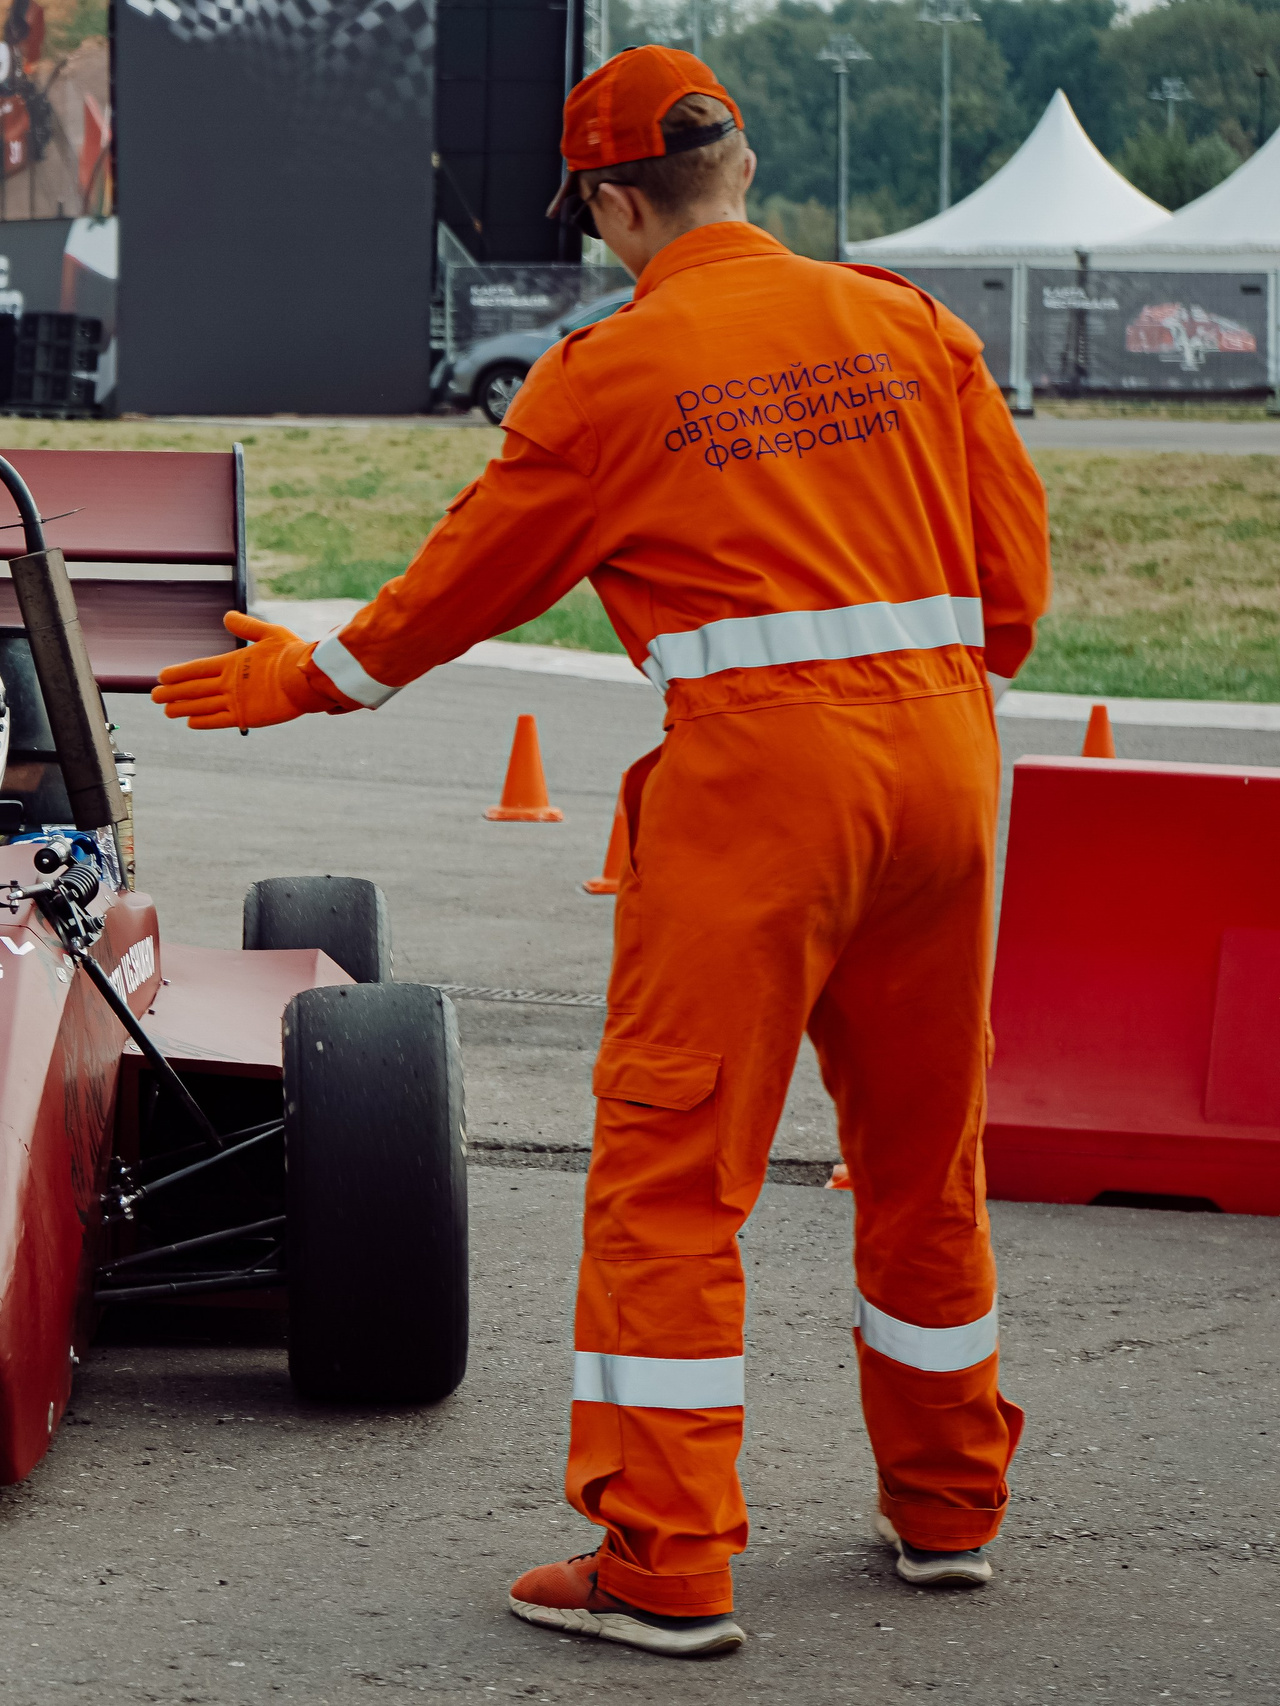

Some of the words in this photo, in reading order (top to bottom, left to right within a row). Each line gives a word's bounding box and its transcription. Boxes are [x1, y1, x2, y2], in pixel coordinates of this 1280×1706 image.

[665, 379, 922, 452] автомобильная
[675, 353, 893, 421] российская
[704, 409, 901, 472] федерация
